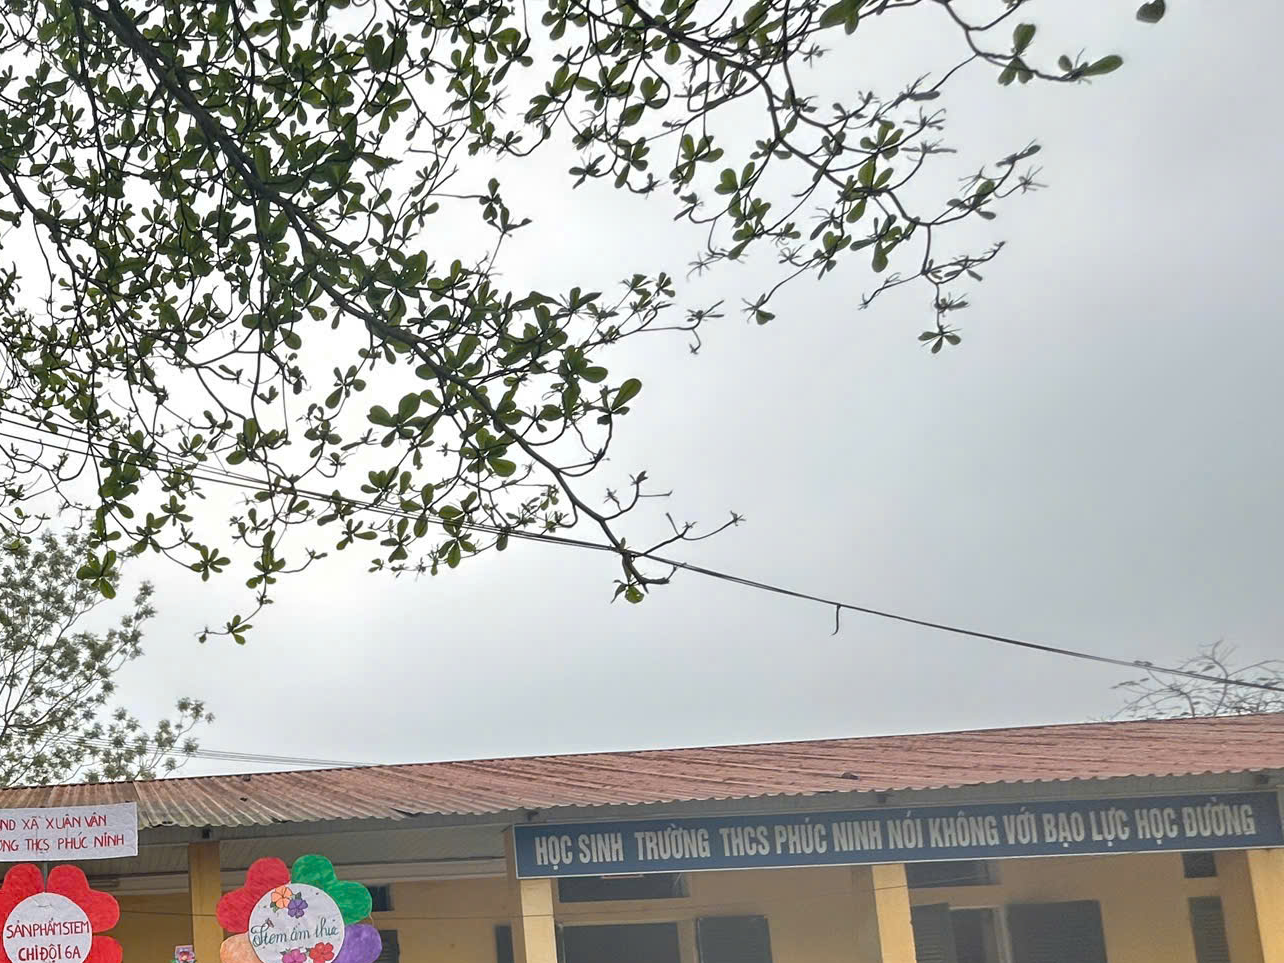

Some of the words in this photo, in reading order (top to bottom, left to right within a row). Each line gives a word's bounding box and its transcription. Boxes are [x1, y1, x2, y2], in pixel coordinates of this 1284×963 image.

[21, 815, 39, 830] XÃ
[46, 813, 82, 830] XUÂN
[84, 811, 107, 828] VÂN
[25, 838, 50, 851] THCS
[57, 832, 88, 850] PHÚC
[534, 835, 573, 870] HỌC
[578, 832, 624, 864] SINH
[634, 823, 711, 861] TRƯỜNG
[719, 826, 768, 857] THCS
[775, 817, 827, 855] PHÚC
[832, 819, 882, 852] NINH
[888, 810, 923, 850] NÓI
[928, 811, 999, 848] KHÔNG
[1002, 806, 1038, 845] VỚI
[1044, 811, 1085, 847] BẠO
[1091, 807, 1130, 847] LỰC
[1135, 806, 1179, 845] HỌC
[1181, 797, 1257, 838] ĐƯỜNG
[65, 945, 81, 959] 6A
